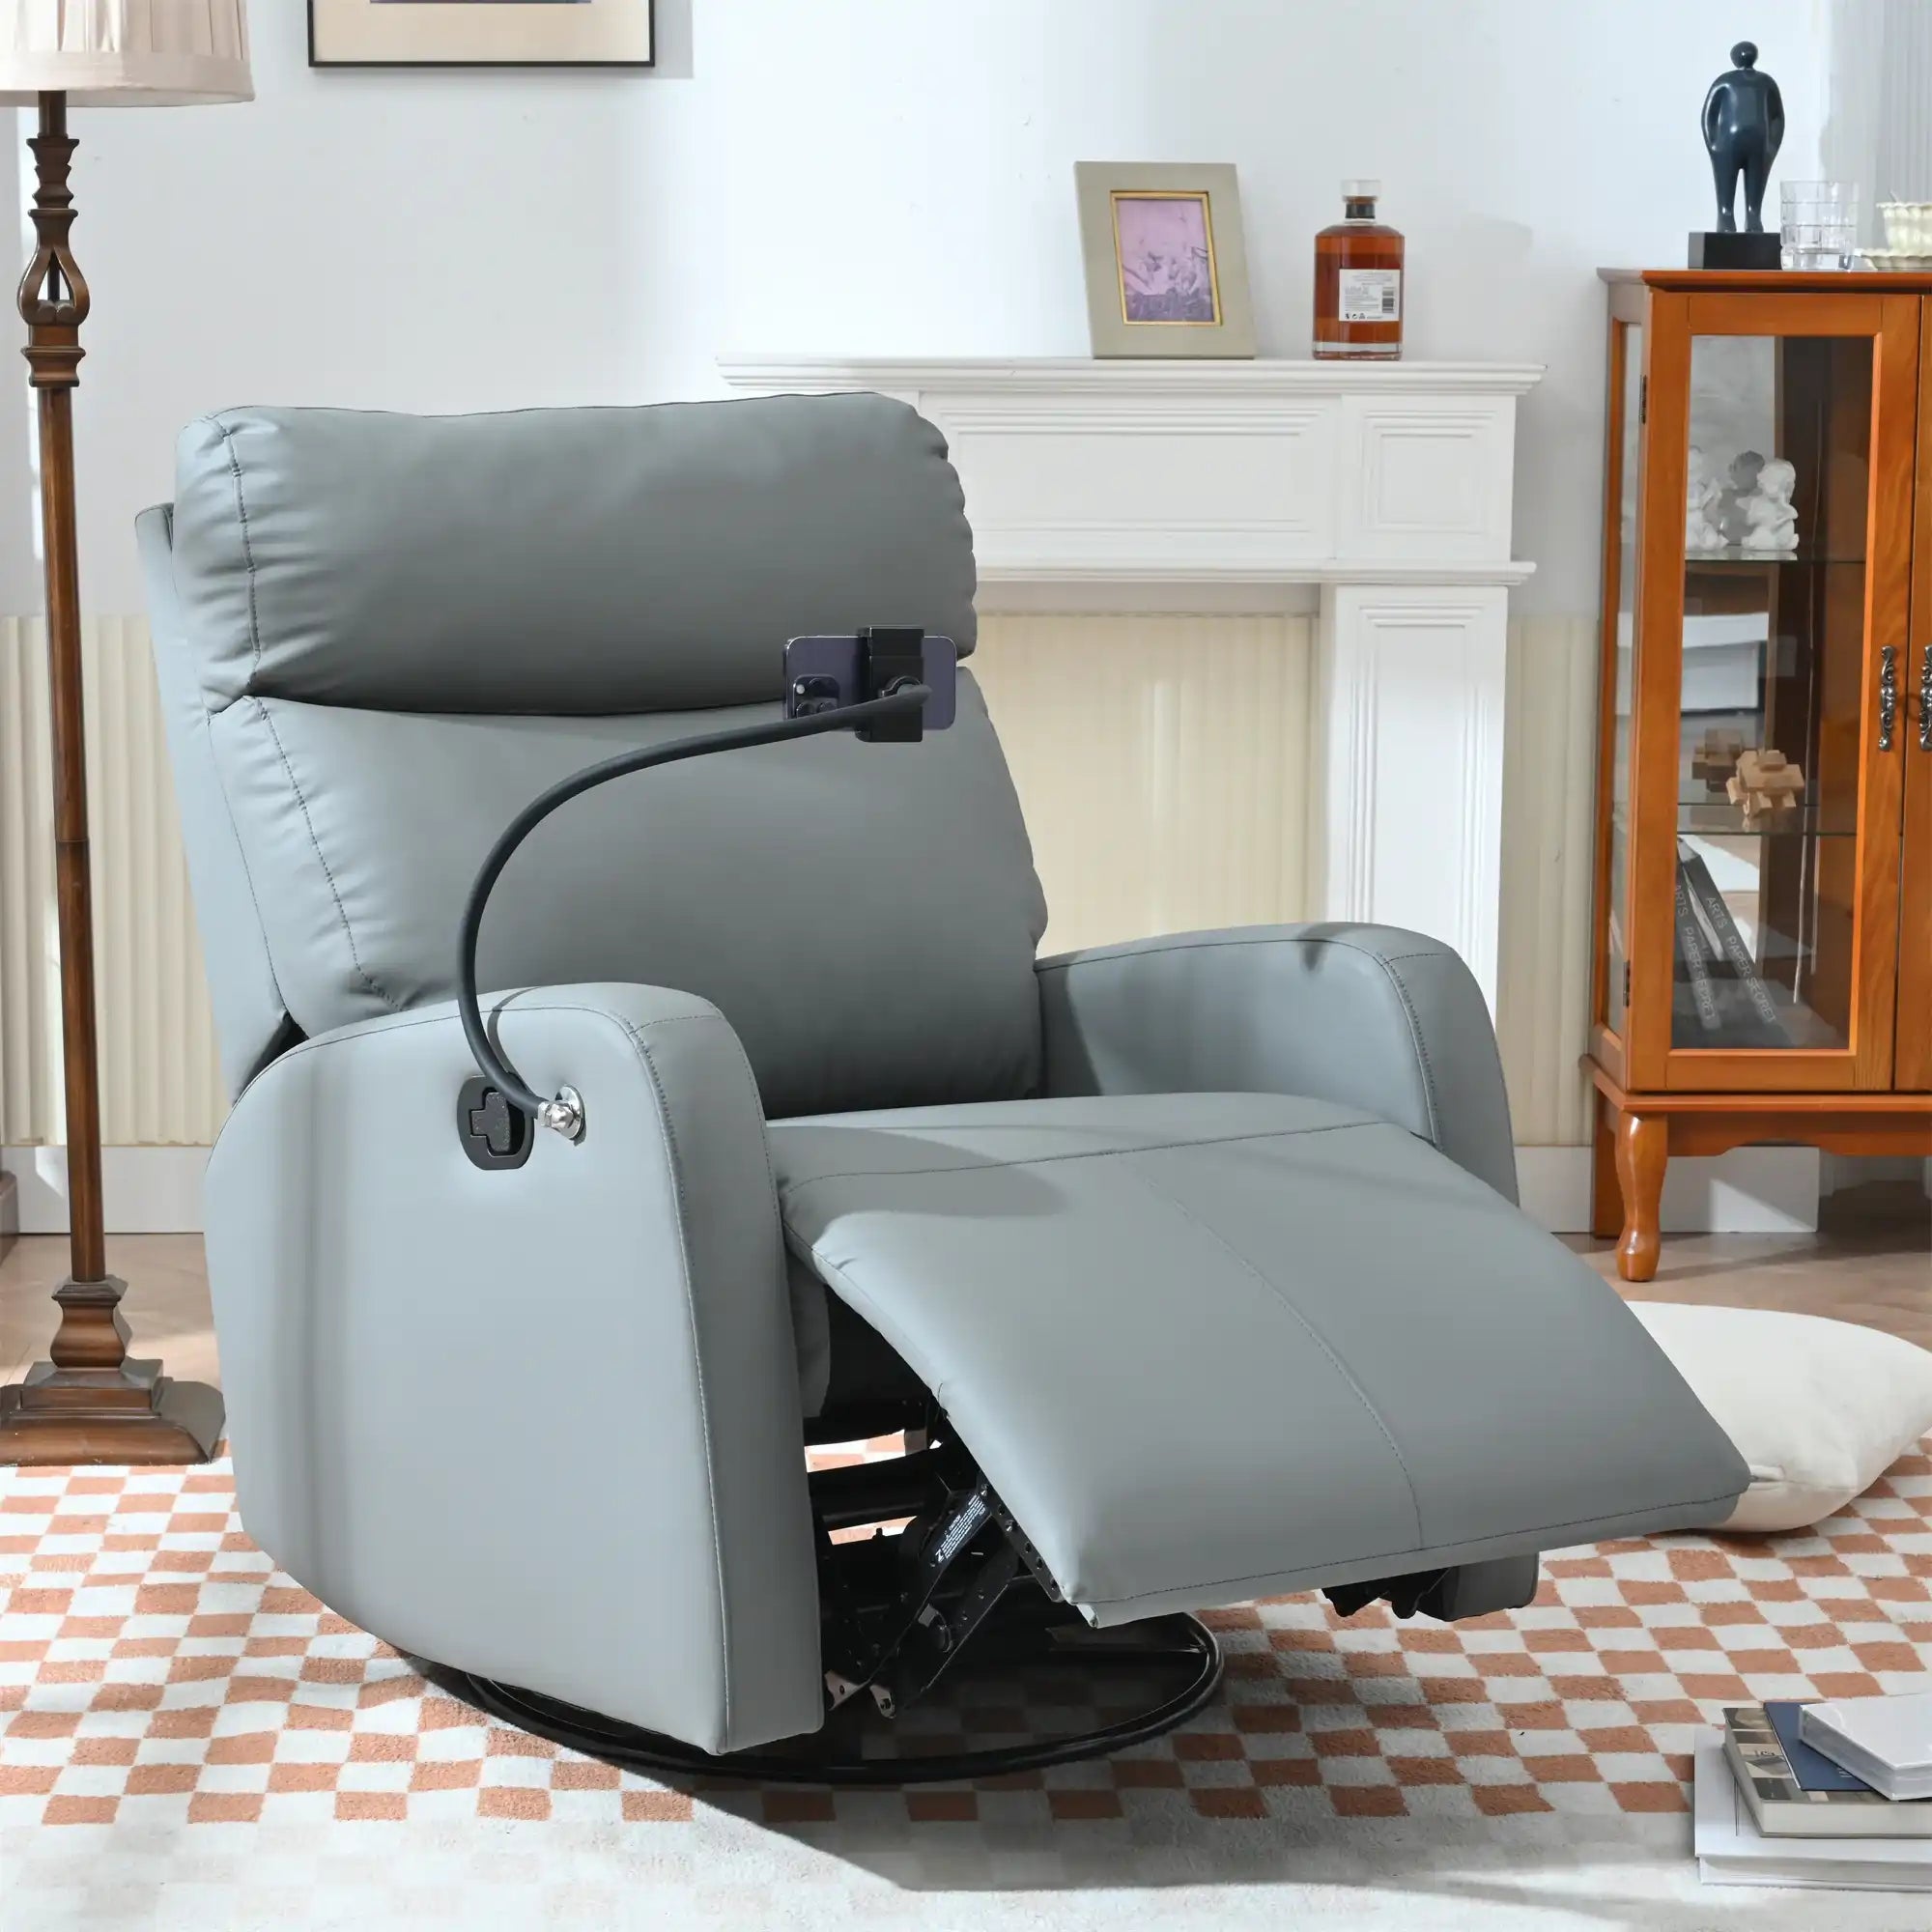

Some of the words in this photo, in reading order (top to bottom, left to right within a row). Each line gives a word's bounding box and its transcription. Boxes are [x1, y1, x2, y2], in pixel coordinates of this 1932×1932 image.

[1675, 885, 1689, 917] ARTS
[1685, 926, 1702, 970] PAPER
[1706, 897, 1728, 929] ARTS
[1727, 936, 1752, 977] PAPER
[1747, 977, 1776, 1023] SECRET
